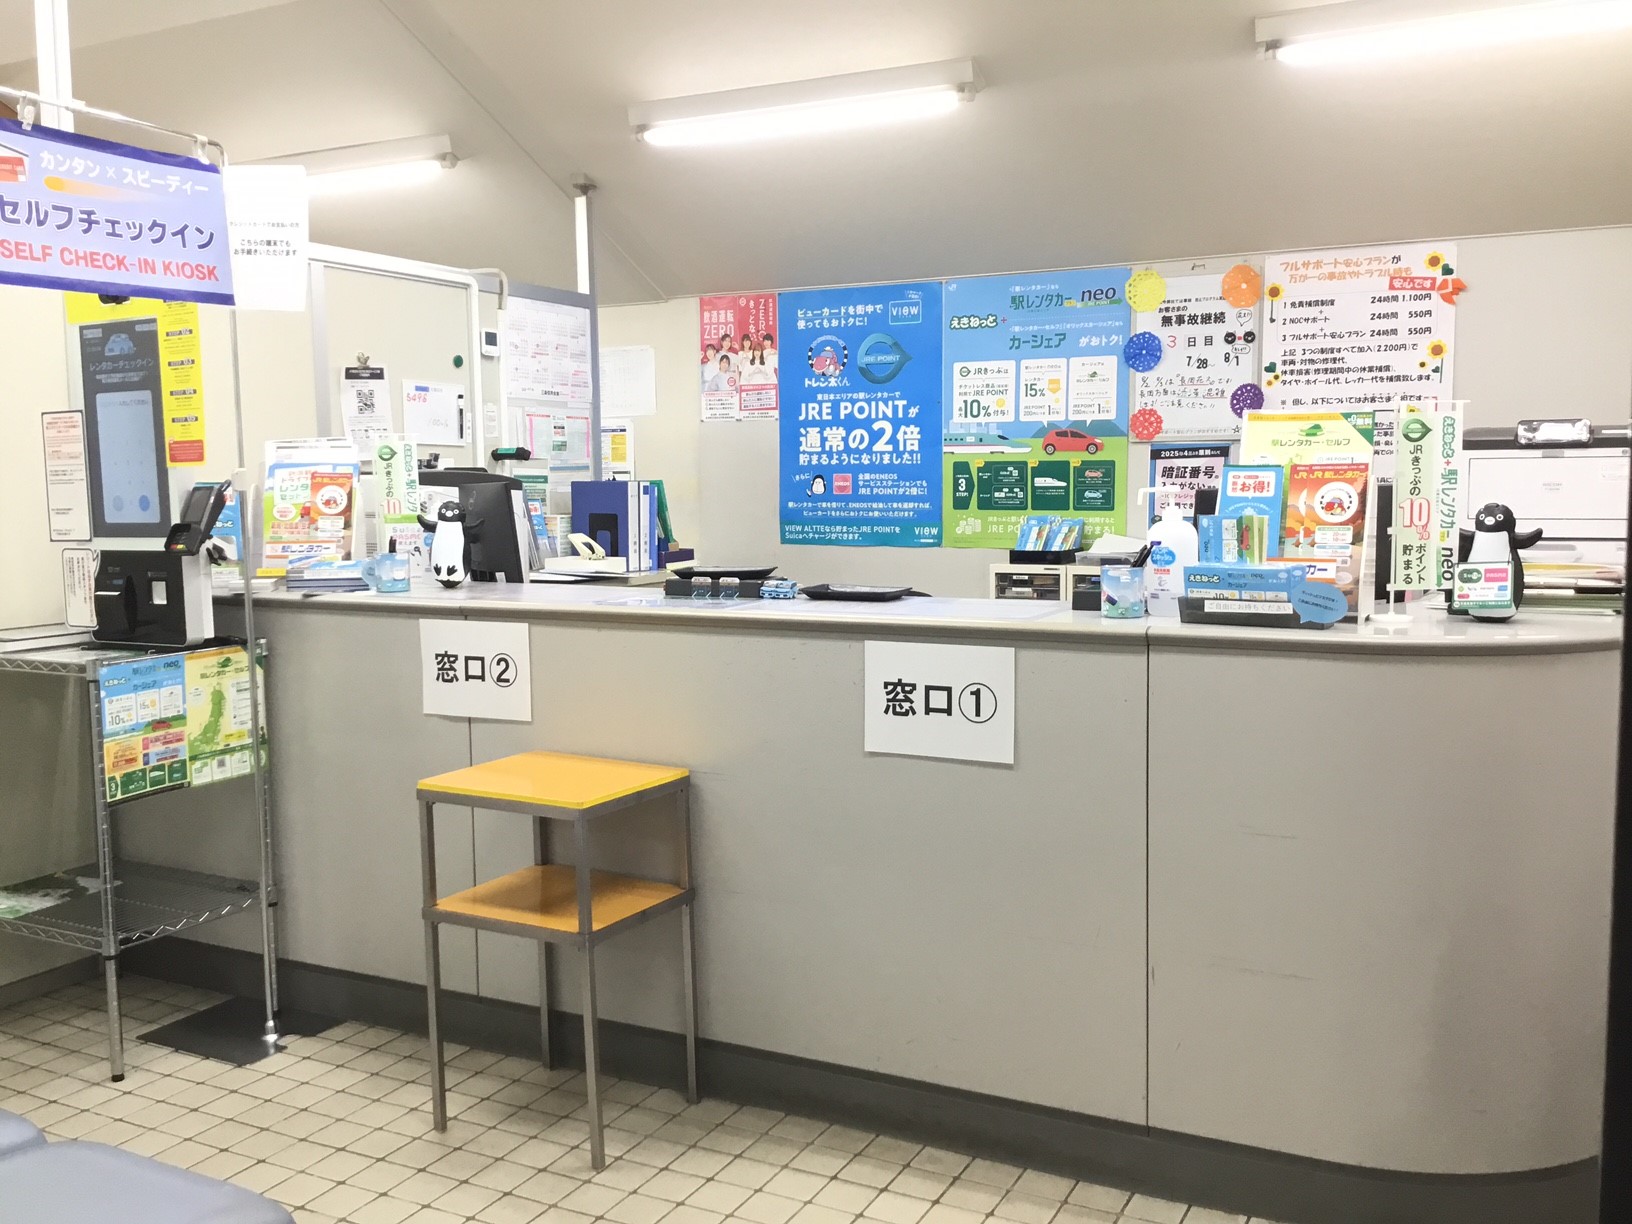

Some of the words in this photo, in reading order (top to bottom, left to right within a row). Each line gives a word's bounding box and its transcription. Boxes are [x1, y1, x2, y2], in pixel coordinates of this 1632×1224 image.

[0, 194, 215, 250] セルフチェックイン
[0, 239, 53, 263] SELF
[59, 246, 157, 275] CHECK-IN
[162, 260, 219, 282] KIOSK
[1279, 254, 1401, 273] フルサポート安心プランが
[1288, 266, 1413, 284] 万が一の事故やトラブル時も
[1392, 277, 1433, 289] 安心です
[1009, 292, 1073, 311] 駅レンタカー
[1081, 287, 1116, 302] neo
[1290, 298, 1335, 309] 免責補償制度
[1370, 294, 1399, 304] 24時間
[704, 310, 734, 324] 飲酒運転
[797, 304, 883, 317] ビューカードを街中で
[1282, 318, 1287, 326] 2
[1289, 316, 1330, 325] NOCサポート
[1370, 311, 1398, 321] 24時間
[1408, 310, 1432, 319] 550円
[797, 317, 868, 330] 使ってもおトクに!
[950, 314, 998, 329] えきねっと
[1161, 311, 1226, 328] 無事故継続
[704, 324, 734, 339] ZERO
[1282, 334, 1287, 342] 3
[1289, 330, 1366, 341] フルサポート安心プラン
[1369, 328, 1398, 338] 24時間
[1408, 327, 1432, 335] 550円
[1009, 332, 1067, 350] カーシェア
[1079, 334, 1123, 347] がおトク!
[1167, 335, 1177, 348] 3
[1281, 349, 1297, 358] 上記
[973, 367, 1009, 376] JRきっぷは
[804, 376, 850, 388] トレン太くん
[816, 391, 901, 401] 東日本エリアの駅レンタカーで
[1024, 383, 1046, 398] 15%
[799, 402, 832, 420] JRE
[963, 399, 991, 418] 10%
[799, 420, 921, 452] 通常の2倍
[1271, 438, 1351, 447] 駅レンタカー・セルフ
[799, 453, 921, 466] 貯まるようになりました!!
[1409, 445, 1423, 497] JRきっぷの
[958, 478, 966, 491] 3
[1240, 480, 1271, 494] お得!
[1440, 468, 1458, 538] 駅レンタカー
[987, 524, 1004, 533] JRE
[1402, 543, 1414, 585] 貯まる
[1415, 543, 1427, 585] ポイント
[1441, 547, 1454, 581] neo
[1188, 574, 1221, 583] えきねっと
[1208, 601, 1291, 612] ご自由にお持ちください
[434, 650, 518, 688] 窓口②
[883, 678, 998, 724] 窓口①
